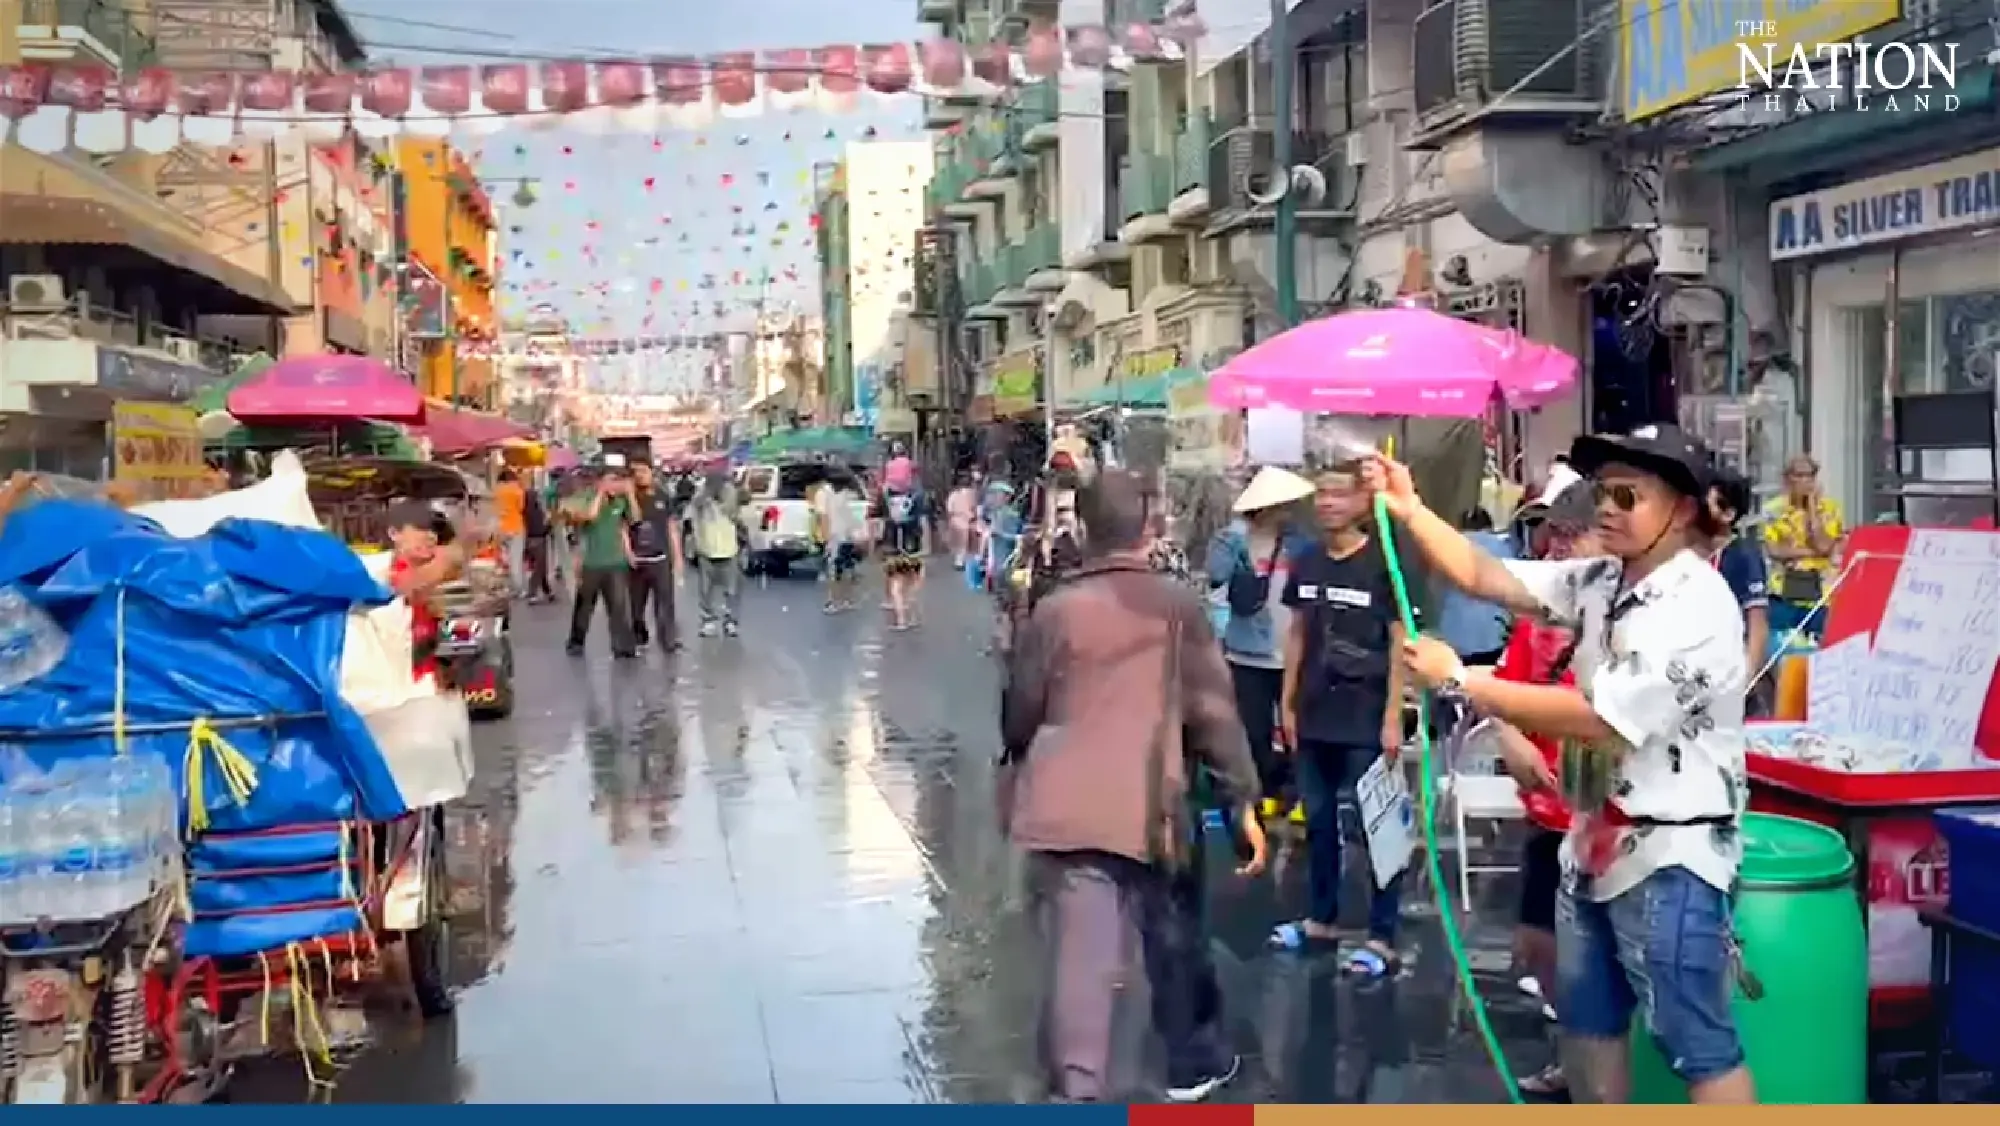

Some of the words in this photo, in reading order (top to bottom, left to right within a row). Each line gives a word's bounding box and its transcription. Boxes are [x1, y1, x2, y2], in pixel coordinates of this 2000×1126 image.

[1777, 202, 1823, 249] AA
[1834, 188, 1922, 239] SILVER
[1933, 168, 2000, 219] TRA
